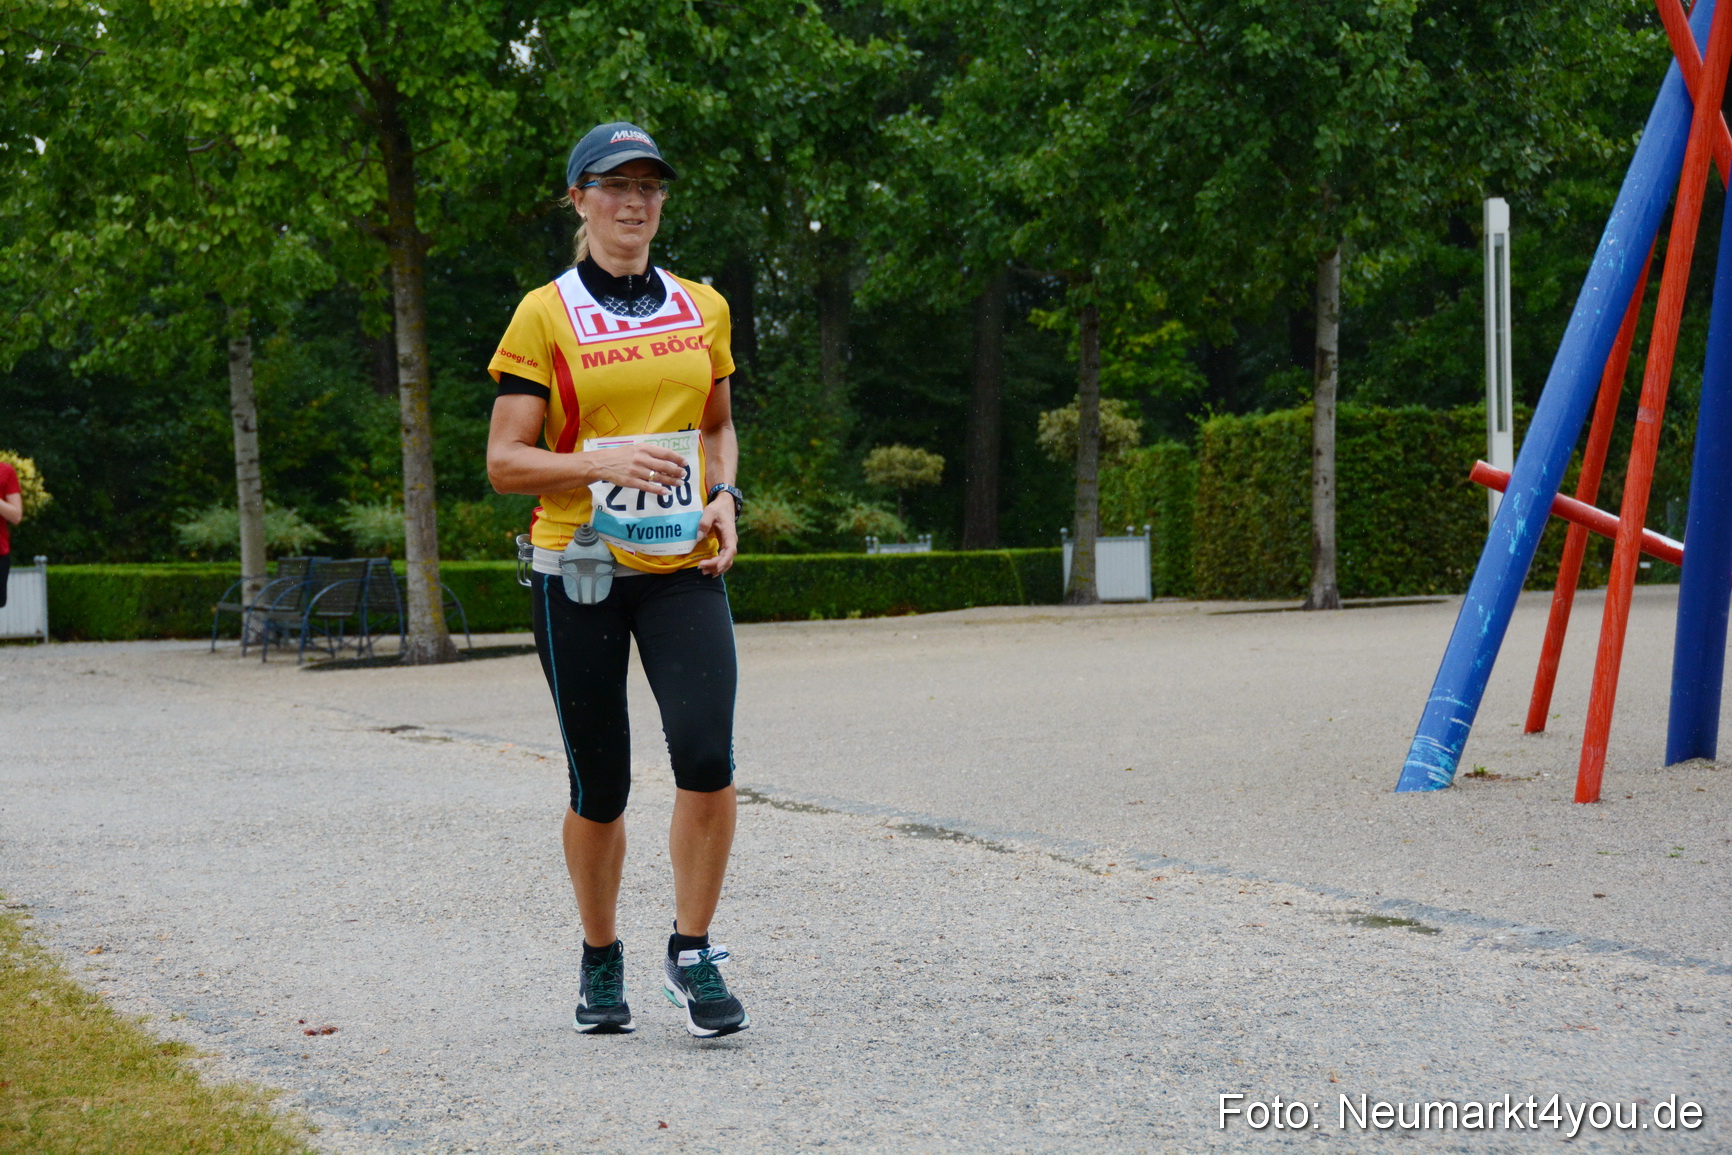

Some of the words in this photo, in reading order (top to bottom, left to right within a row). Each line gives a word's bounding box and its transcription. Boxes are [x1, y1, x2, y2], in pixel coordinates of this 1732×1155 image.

[494, 347, 539, 368] -boegl.de
[580, 345, 644, 370] MAX
[649, 334, 710, 357] BÖGL
[625, 523, 682, 540] Yvonne
